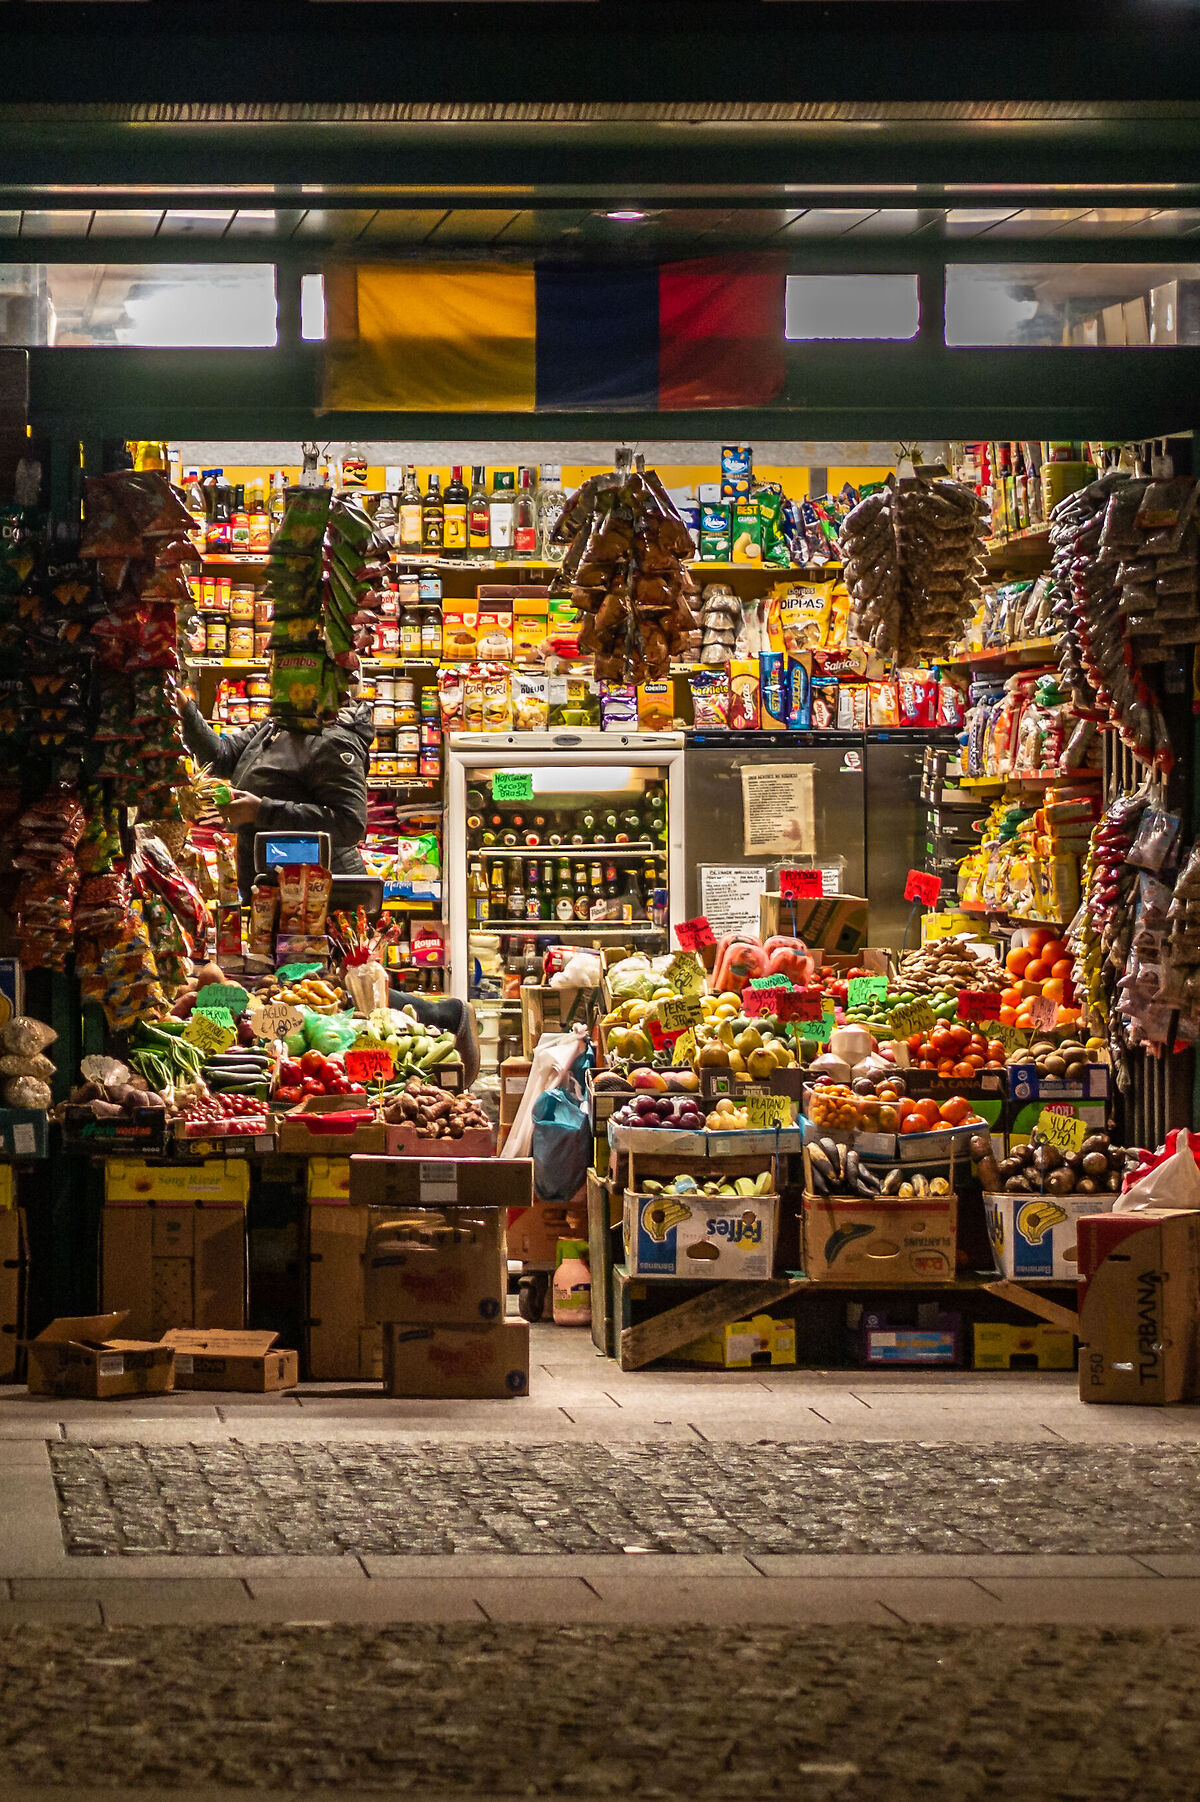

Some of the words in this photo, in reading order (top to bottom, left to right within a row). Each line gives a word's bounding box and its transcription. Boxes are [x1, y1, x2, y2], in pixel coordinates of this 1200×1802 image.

[737, 506, 759, 516] BEST
[414, 938, 440, 950] Royal
[263, 1006, 288, 1020] AGLIO
[664, 1001, 687, 1017] PERE
[1050, 1116, 1077, 1135] YUCA
[1137, 1269, 1160, 1386] TURBANA
